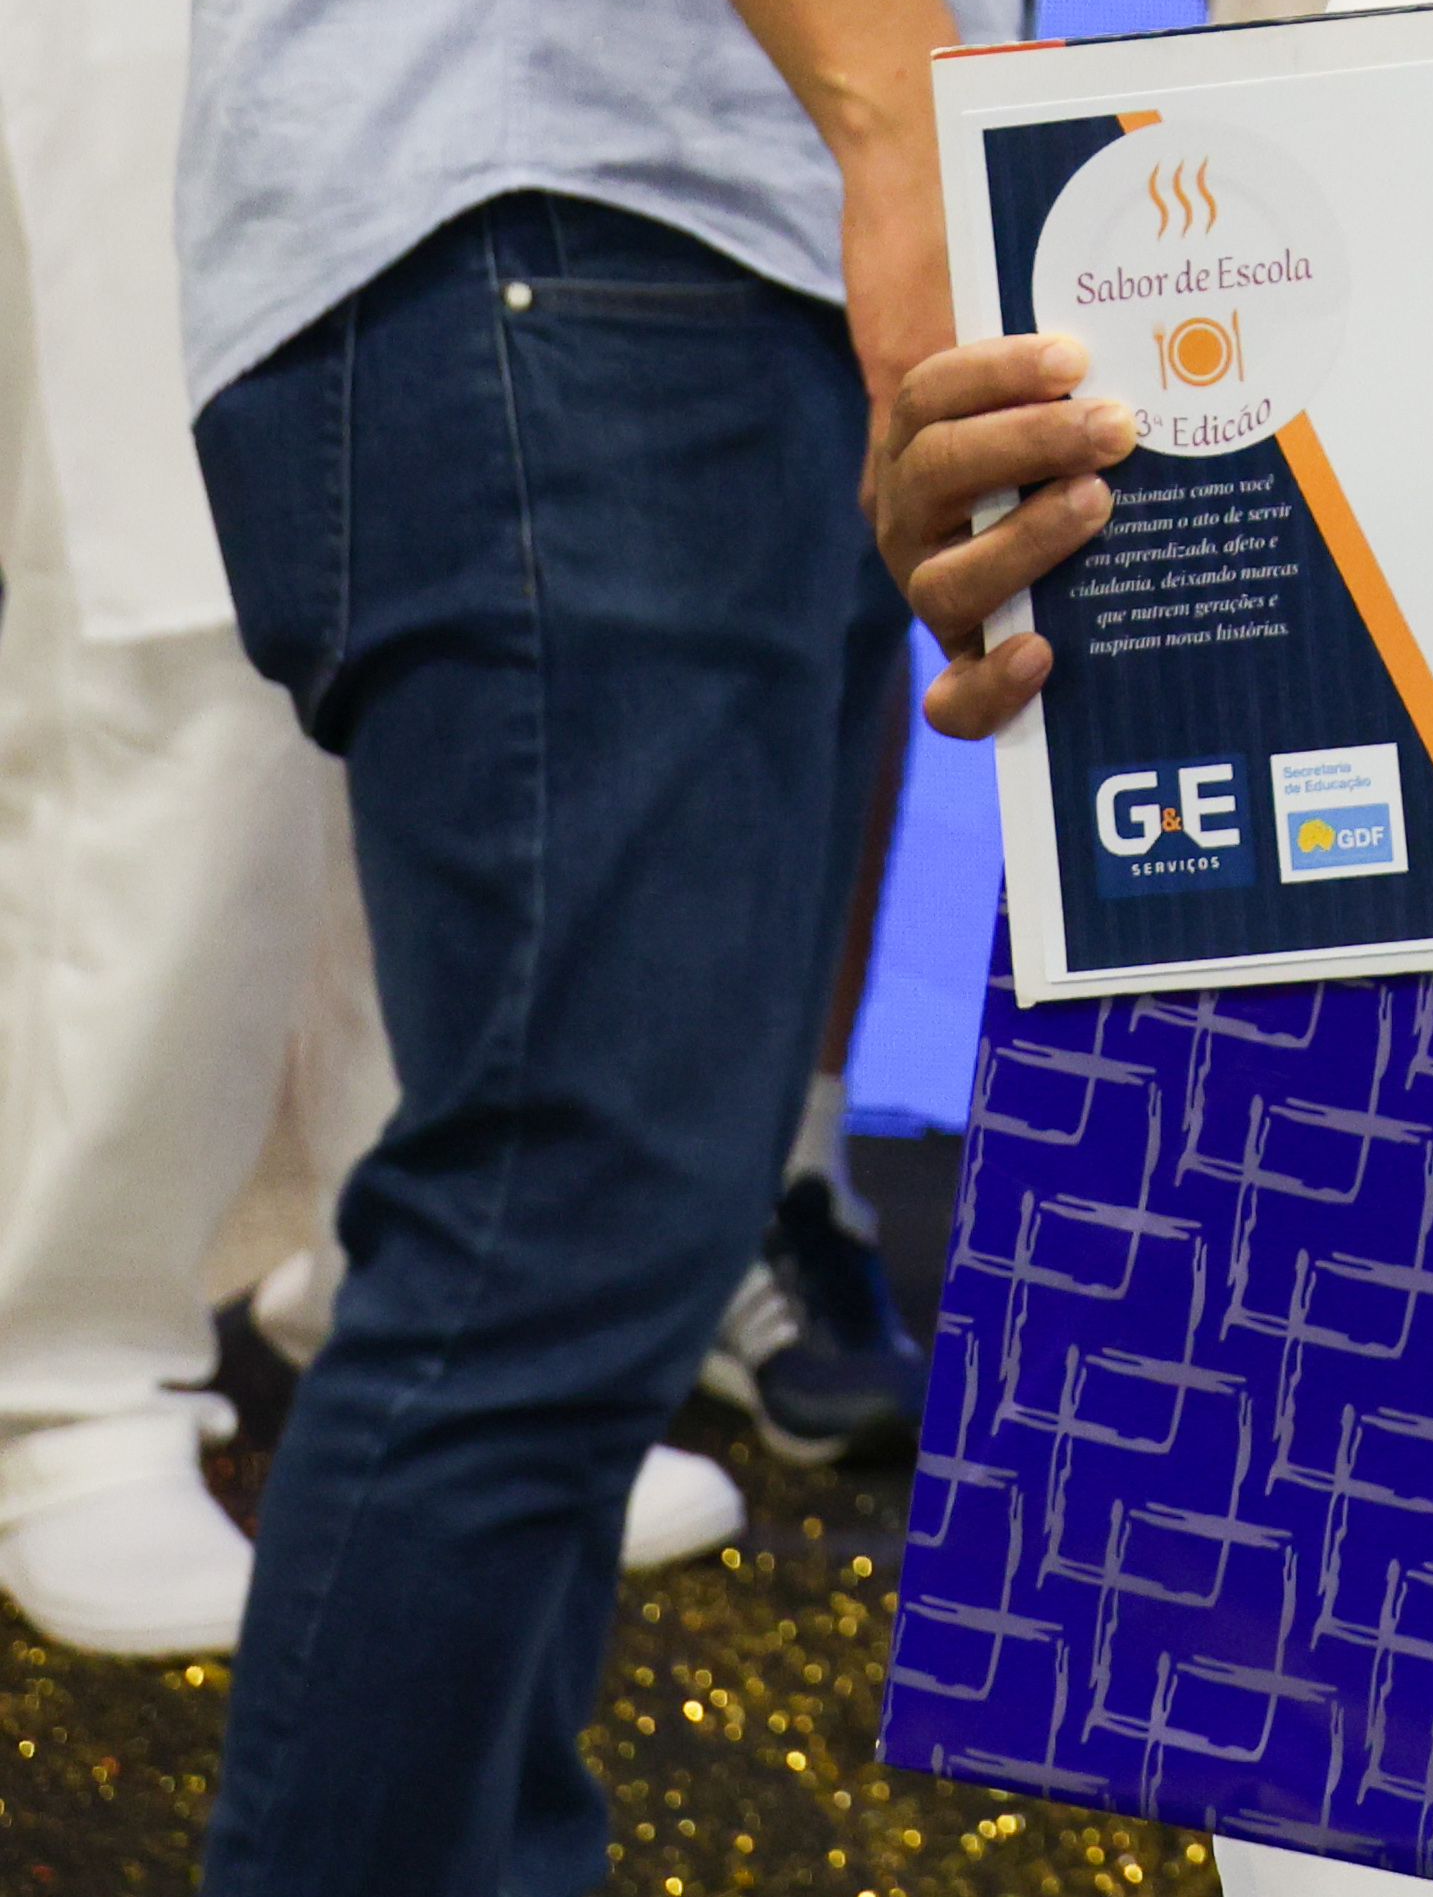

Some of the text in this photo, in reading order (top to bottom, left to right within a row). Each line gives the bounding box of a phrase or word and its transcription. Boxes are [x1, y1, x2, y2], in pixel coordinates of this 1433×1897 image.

[1076, 248, 1313, 305] Sabor de Escola
[1190, 481, 1234, 499] como
[1239, 473, 1275, 493] você
[1177, 515, 1189, 529] o
[1192, 511, 1220, 528] ato
[1223, 505, 1244, 524] de
[1248, 501, 1292, 521] servir
[1085, 552, 1111, 568] em
[1223, 533, 1266, 555] afeto
[1269, 535, 1279, 550] e
[1161, 564, 1237, 590] deixando
[1240, 563, 1299, 582] marcas
[1096, 592, 1279, 630] que nutrem gerações e
[1089, 633, 1162, 658] inspiram
[1165, 627, 1211, 647] novas
[1283, 762, 1352, 780] Secretaria
[1283, 775, 1372, 796] de Educação
[1095, 762, 1241, 856] G&E
[1336, 825, 1385, 850] GDF
[1130, 856, 1221, 878] SERVIÇOS
